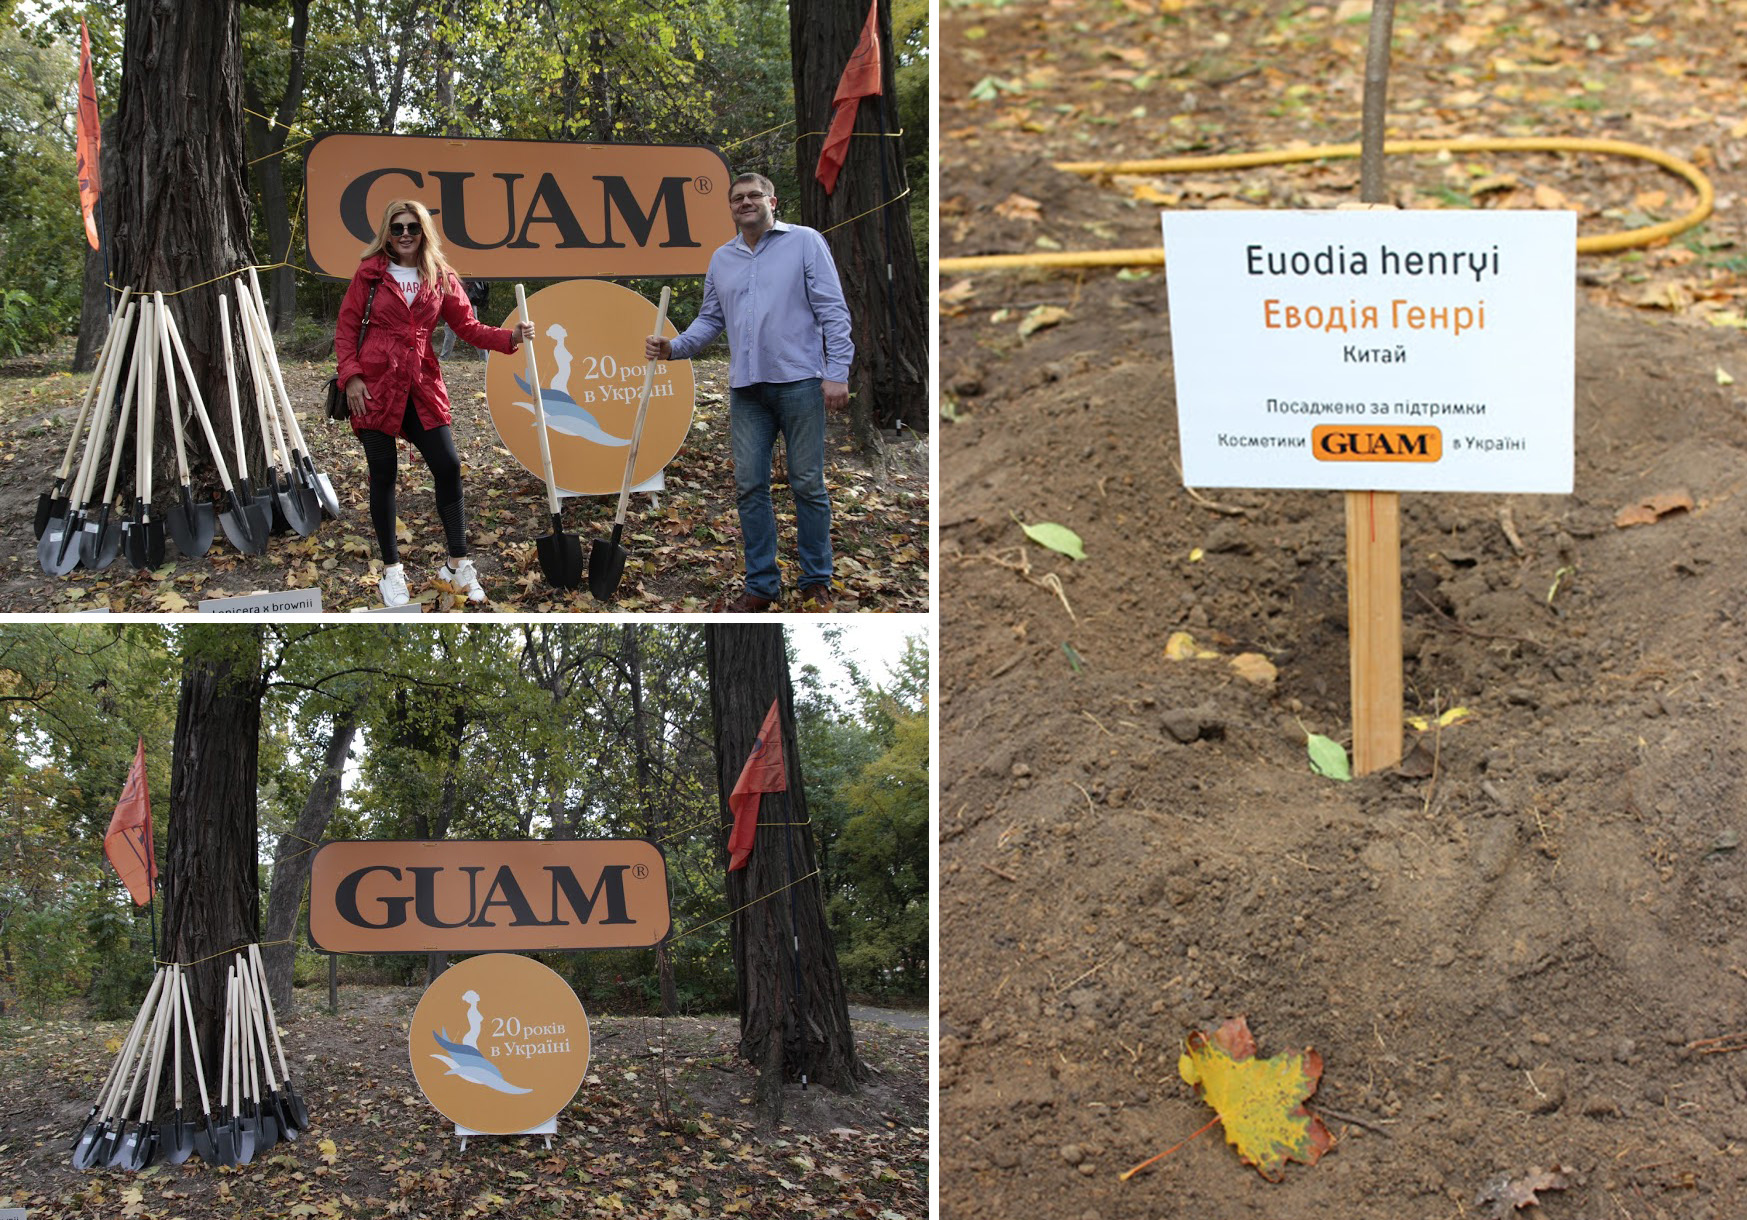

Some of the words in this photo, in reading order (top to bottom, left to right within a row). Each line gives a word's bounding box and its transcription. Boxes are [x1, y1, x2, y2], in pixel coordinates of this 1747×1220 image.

[1247, 244, 1368, 276] Euodia
[1380, 244, 1500, 282] henryi
[1263, 298, 1378, 333] Еводія
[1391, 299, 1485, 336] Генрі
[1343, 344, 1407, 364] Китай
[582, 355, 617, 379] 20
[619, 363, 667, 382] ров
[583, 390, 596, 403] в
[1266, 398, 1366, 416] Посаджено
[1369, 402, 1390, 416] за
[1393, 399, 1486, 418] підтримки
[1217, 432, 1306, 449] Косметики
[1452, 438, 1462, 450] в
[1464, 435, 1526, 453] Україні
[272, 599, 313, 612] brownii
[491, 1016, 521, 1037] 20
[523, 1021, 566, 1040] років
[490, 1046, 501, 1057] в
[503, 1038, 571, 1059] Україні
